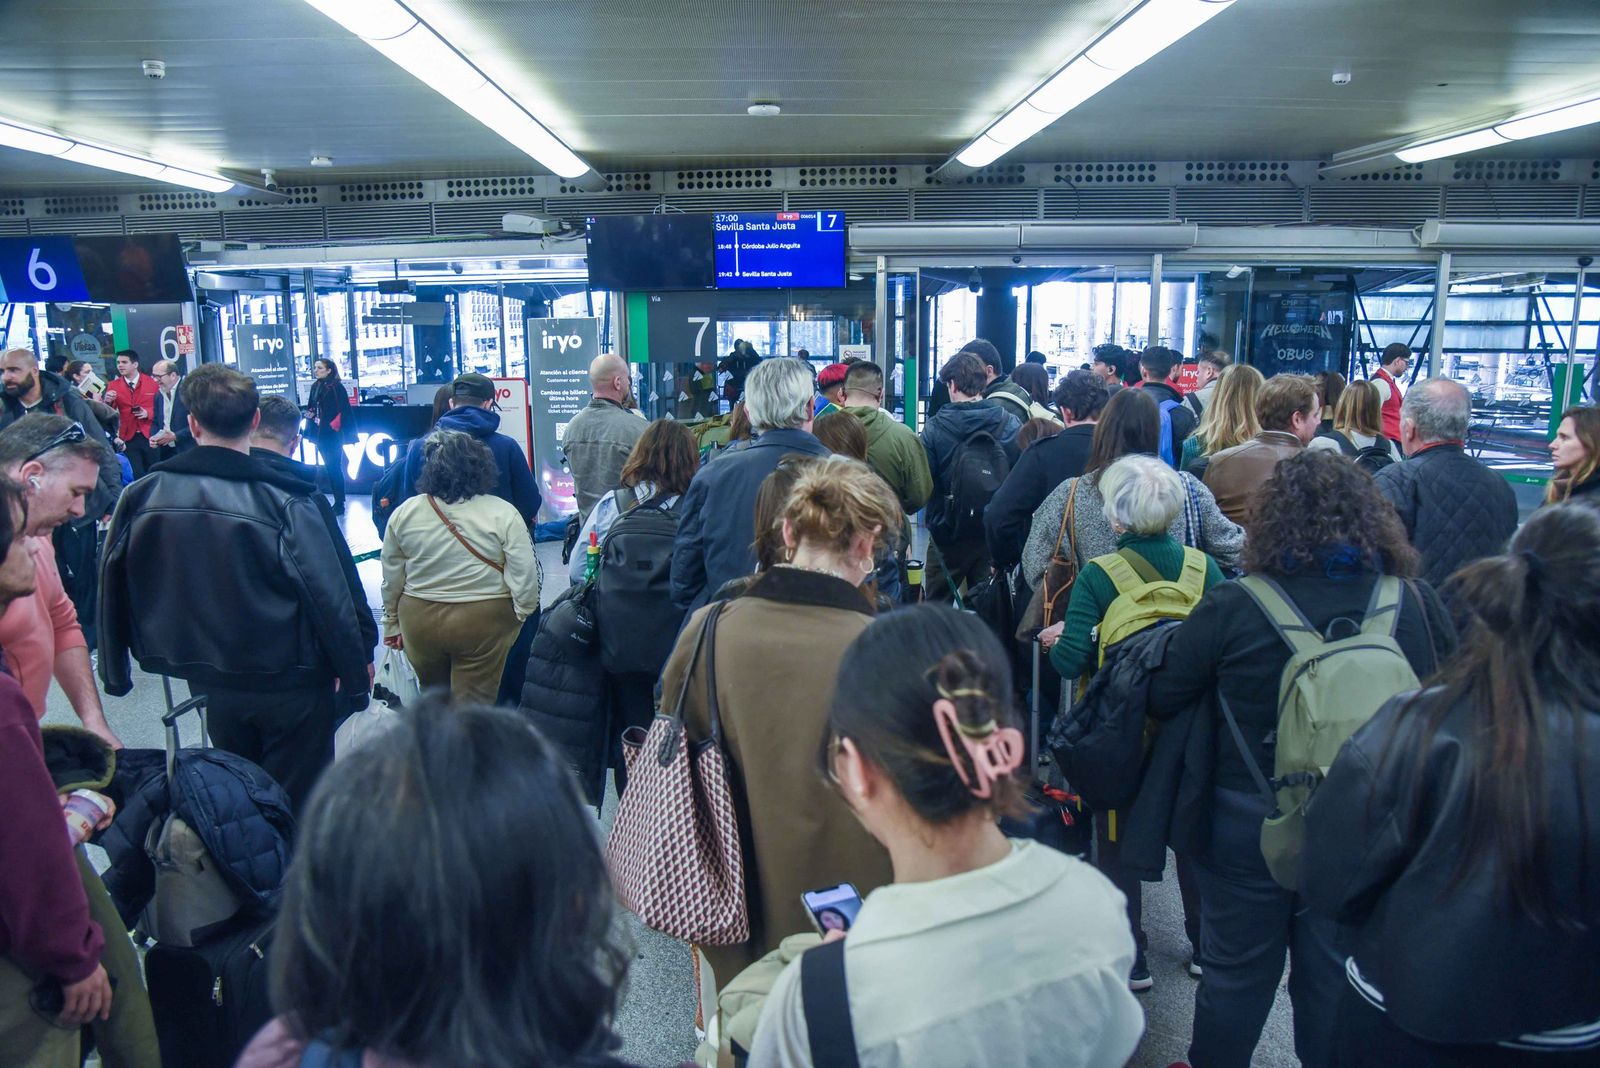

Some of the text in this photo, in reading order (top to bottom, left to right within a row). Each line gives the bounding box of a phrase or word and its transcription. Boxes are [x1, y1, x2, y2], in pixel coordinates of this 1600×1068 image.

[715, 214, 739, 222] 17:00
[716, 221, 796, 231] Sevilla Santa Justa
[827, 214, 837, 228] 7
[780, 242, 801, 250] Anguita
[28, 248, 58, 291] 6
[687, 316, 711, 357] 7
[1260, 323, 1333, 340] HELLOWEEN
[160, 326, 180, 364] 6
[252, 334, 284, 355] iryo
[541, 329, 583, 355] iryo
[1277, 348, 1315, 361] OBUS
